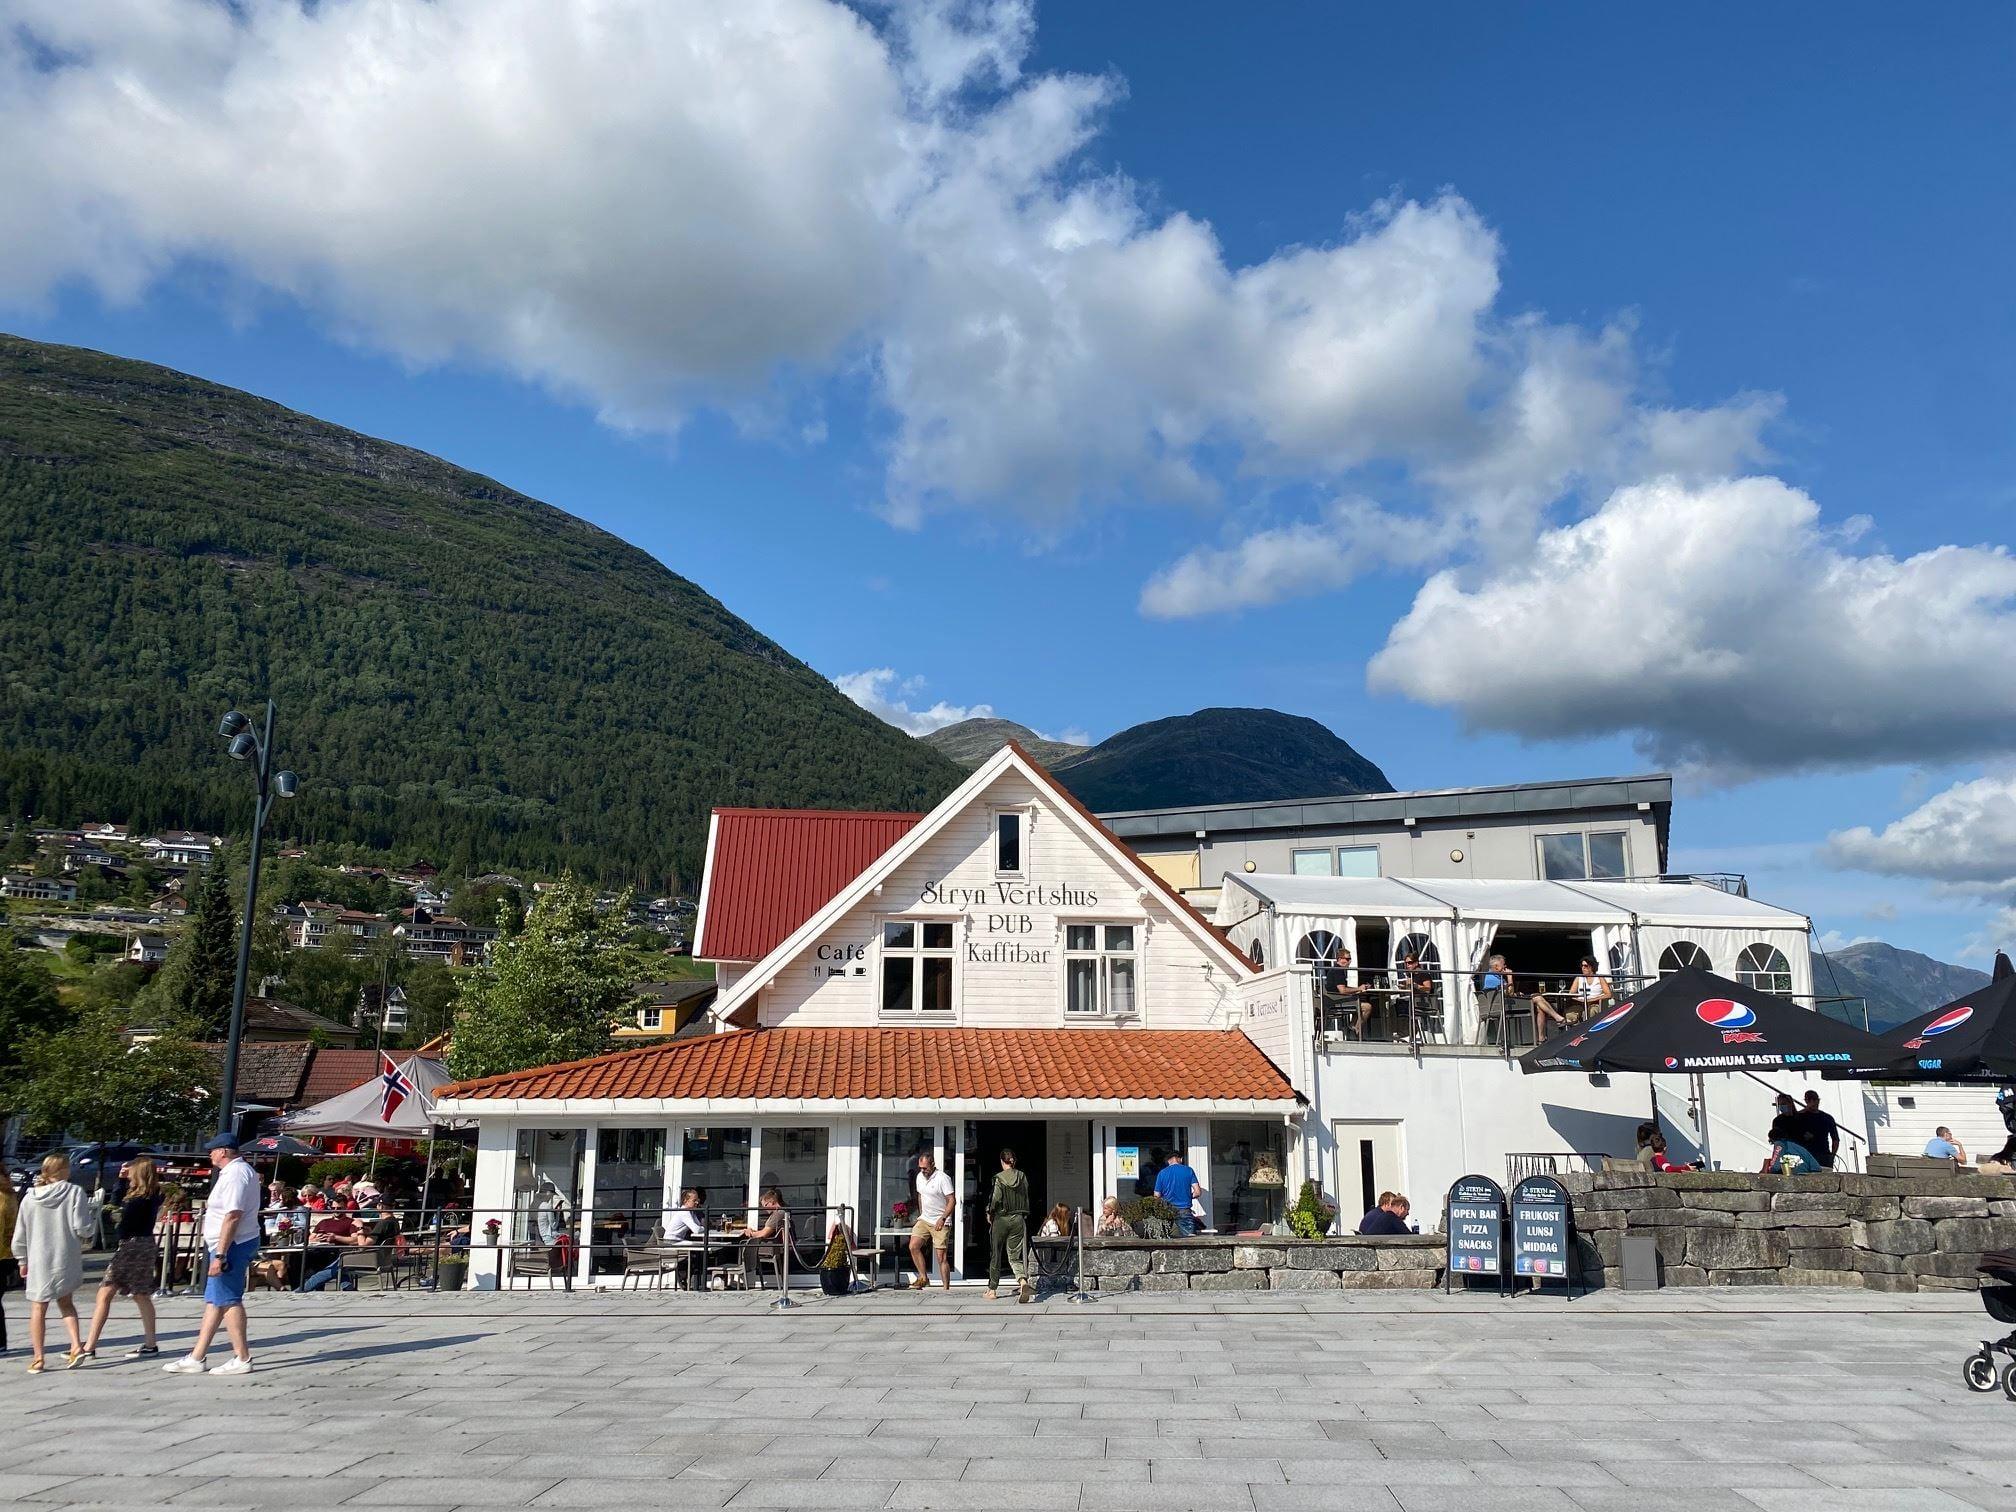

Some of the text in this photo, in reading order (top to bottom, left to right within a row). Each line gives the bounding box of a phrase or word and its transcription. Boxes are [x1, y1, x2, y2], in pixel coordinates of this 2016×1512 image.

[920, 881, 1098, 911] Stryn Vertshus
[988, 914, 1033, 934] PUB
[817, 944, 865, 961] Café
[967, 943, 1051, 964] Kaffibar
[1684, 1052, 1852, 1067] MAXIMUM TASTE NO SUGAR
[1918, 1059, 1942, 1069] SUGAR
[1453, 1209, 1497, 1219] OPEN BAR
[1520, 1210, 1560, 1221] FRUKOST
[1462, 1225, 1488, 1234] PIZZA
[1526, 1226, 1553, 1237] LUNSJ
[1458, 1240, 1493, 1250] SNACKS
[1523, 1241, 1558, 1252] MIDDAG
